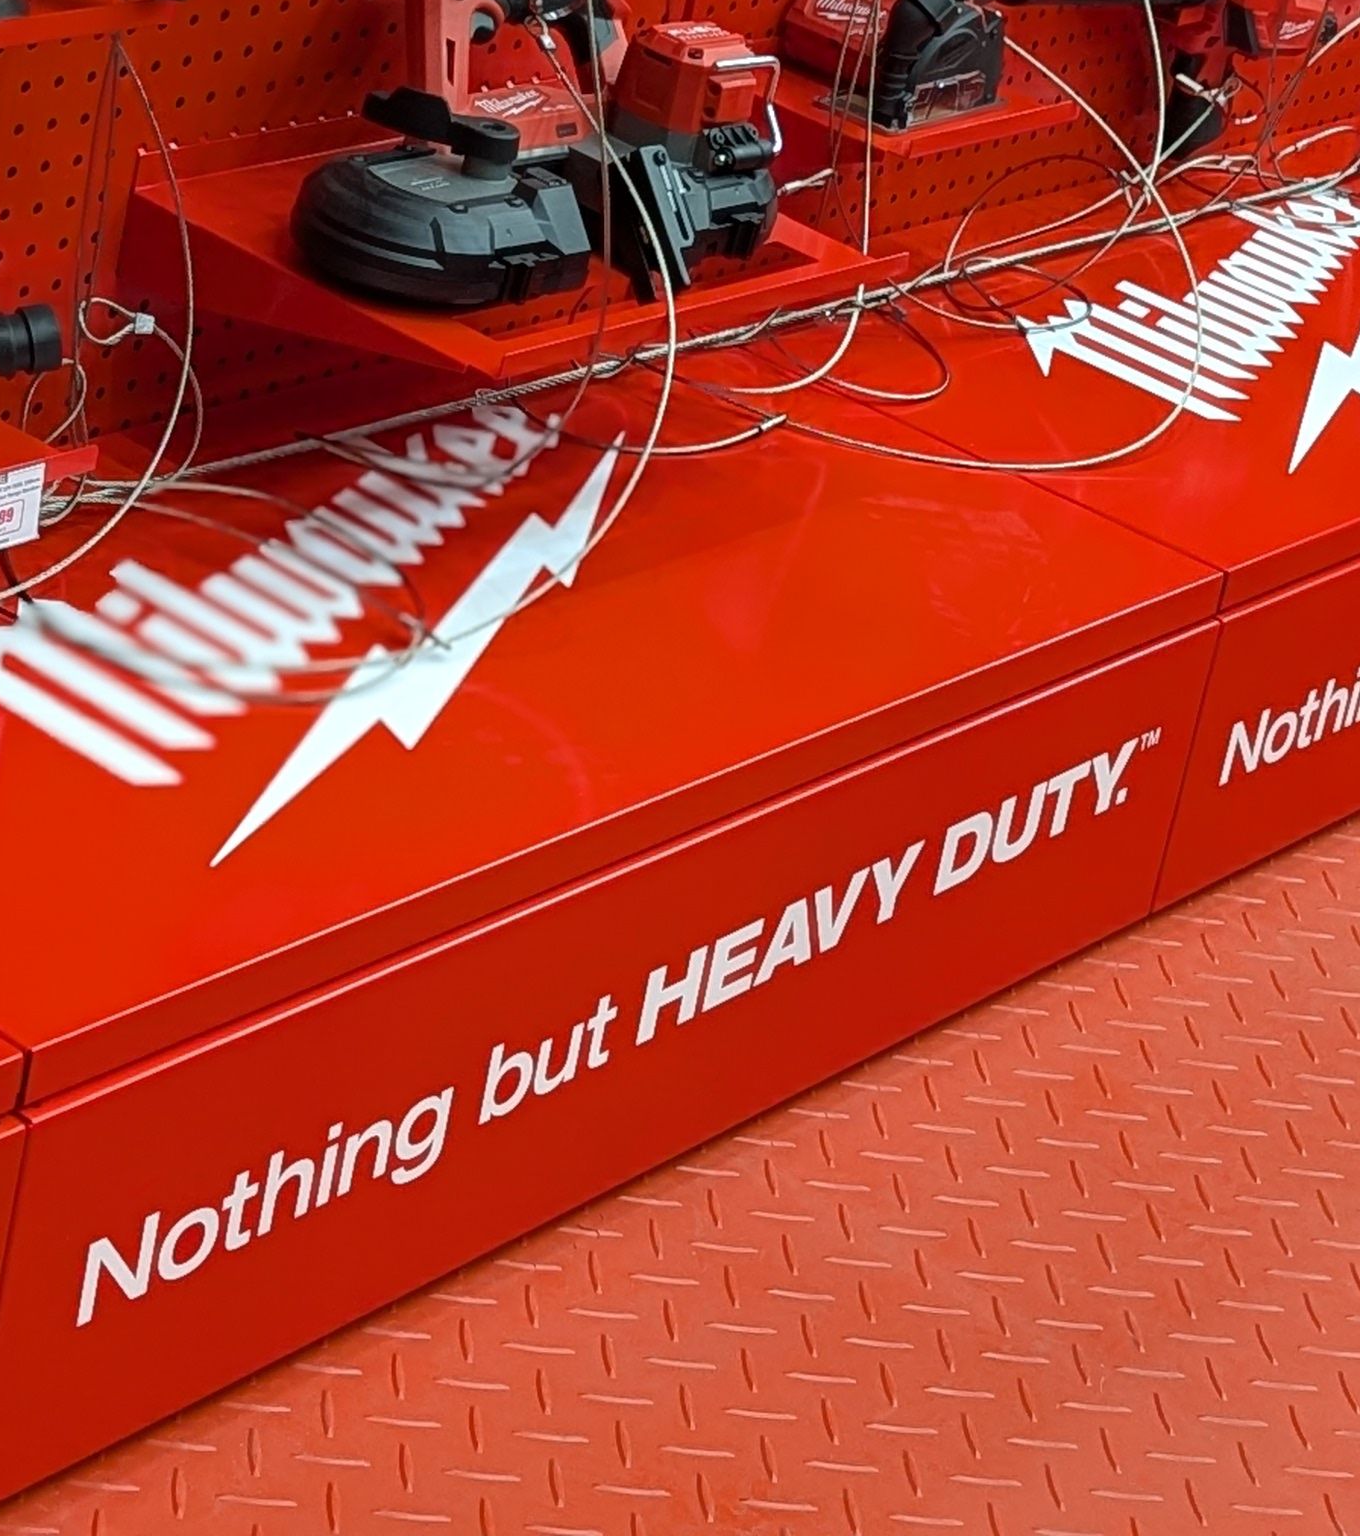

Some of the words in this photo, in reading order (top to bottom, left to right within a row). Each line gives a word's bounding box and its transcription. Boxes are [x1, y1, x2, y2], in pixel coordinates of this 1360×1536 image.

[75, 1085, 453, 1327] Nothing
[477, 994, 615, 1126] but
[635, 842, 923, 1047] HEAVY
